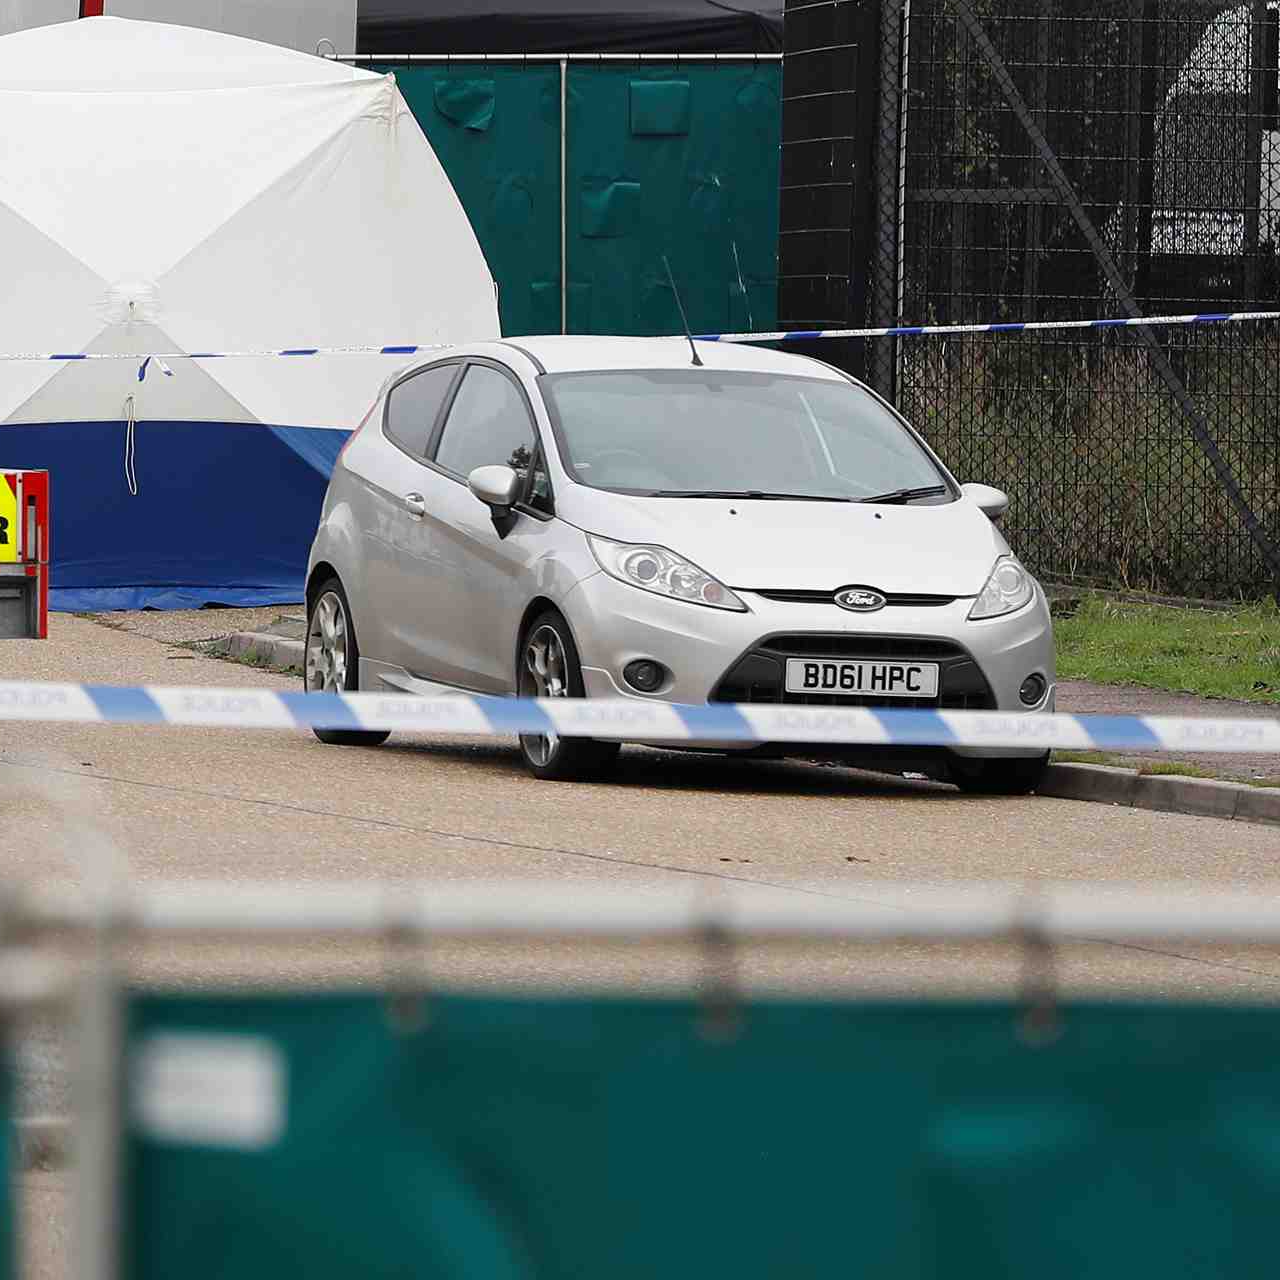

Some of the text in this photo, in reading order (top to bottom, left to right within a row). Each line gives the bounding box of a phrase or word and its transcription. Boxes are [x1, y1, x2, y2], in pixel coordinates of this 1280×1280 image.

[846, 590, 875, 606] Ford
[803, 663, 922, 692] BD61 HPC
